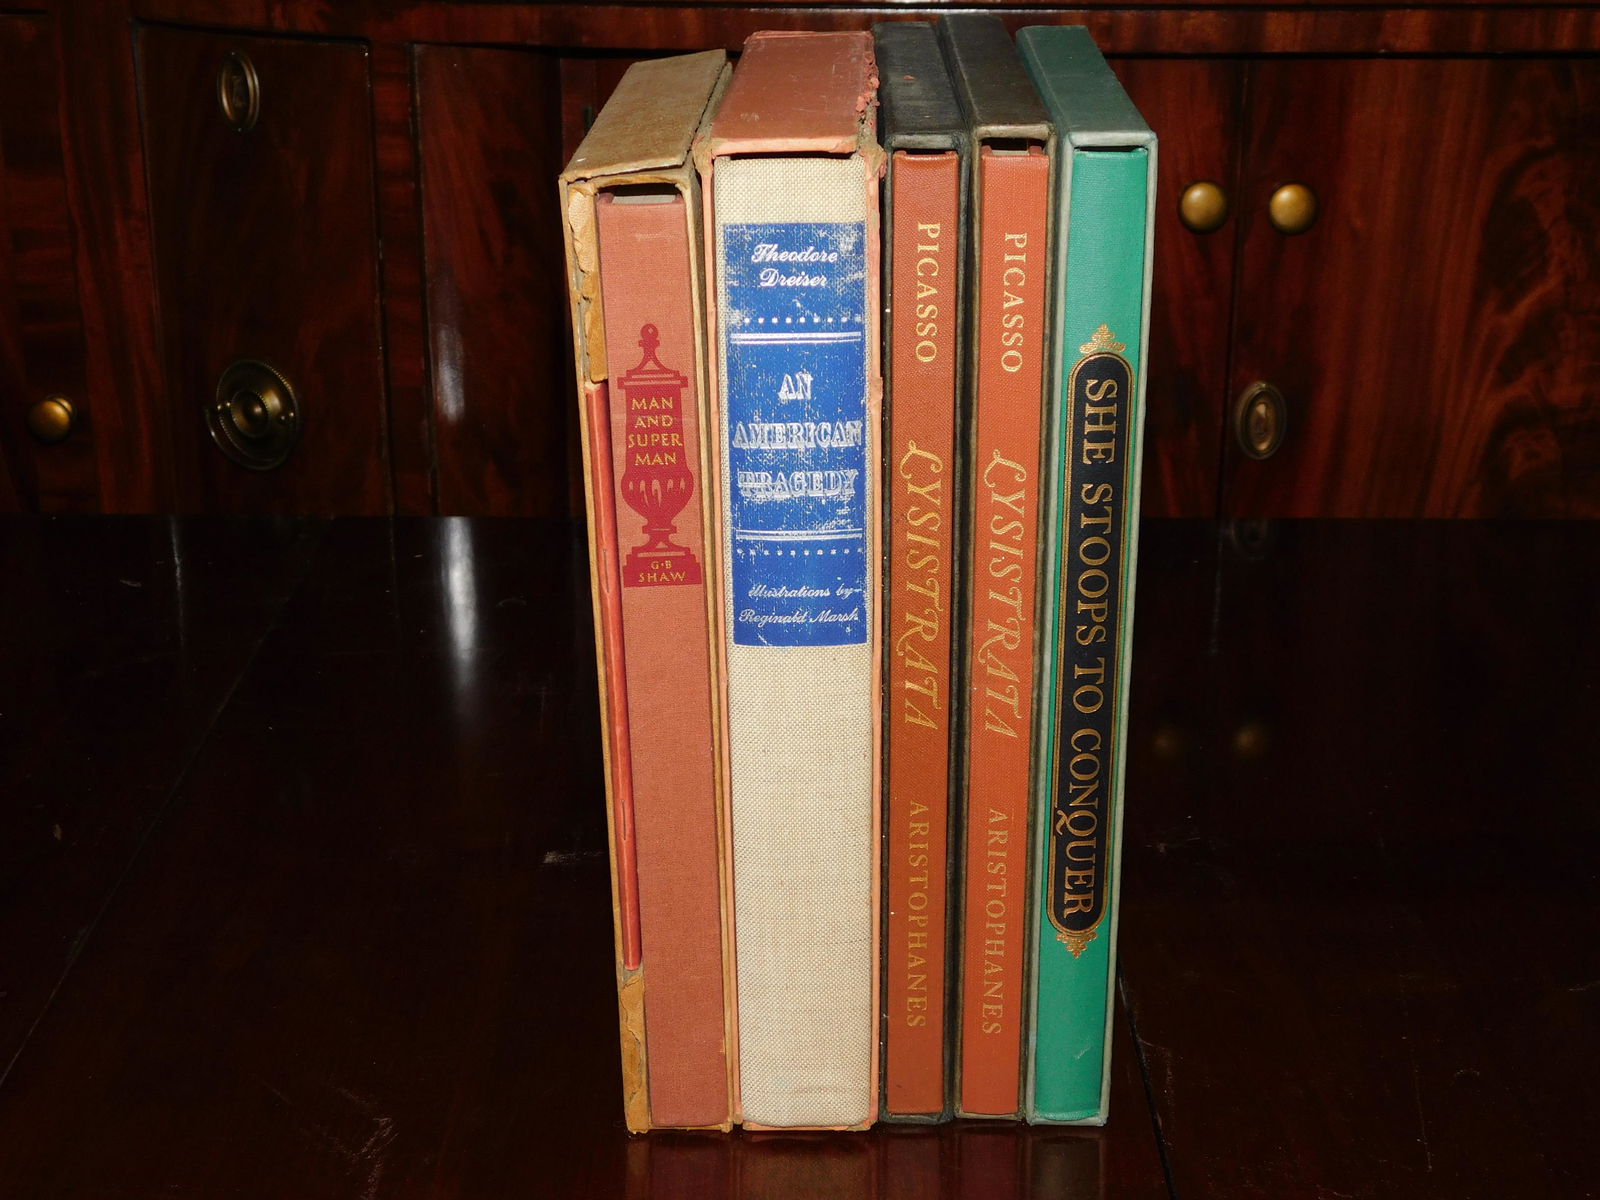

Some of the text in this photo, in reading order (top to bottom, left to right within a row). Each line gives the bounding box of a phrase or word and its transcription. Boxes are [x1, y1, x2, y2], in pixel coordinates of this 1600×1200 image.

[751, 243, 838, 263] Theodore
[759, 267, 828, 287] Dreiser
[915, 221, 941, 363] PICASSO
[1001, 232, 1028, 373] PICASSO
[777, 371, 814, 400] AN
[631, 397, 674, 411] MAN
[634, 415, 674, 428] AND
[732, 420, 863, 449] AMERICAN
[628, 433, 683, 448] SUPER
[634, 452, 677, 466] MAN
[737, 469, 859, 499] TRAGEDY
[638, 571, 686, 583] SHAW
[836, 582, 862, 600] by
[895, 439, 944, 730] LYSISTRATA
[977, 448, 1027, 739] LYSISTRATA
[738, 608, 859, 628] Reginald Marsh
[1056, 378, 1118, 919] SHE STOOPS TO CONQUER
[906, 800, 930, 1028] ARISTOPHANES
[981, 807, 1009, 1036] ARISTOPHANES
